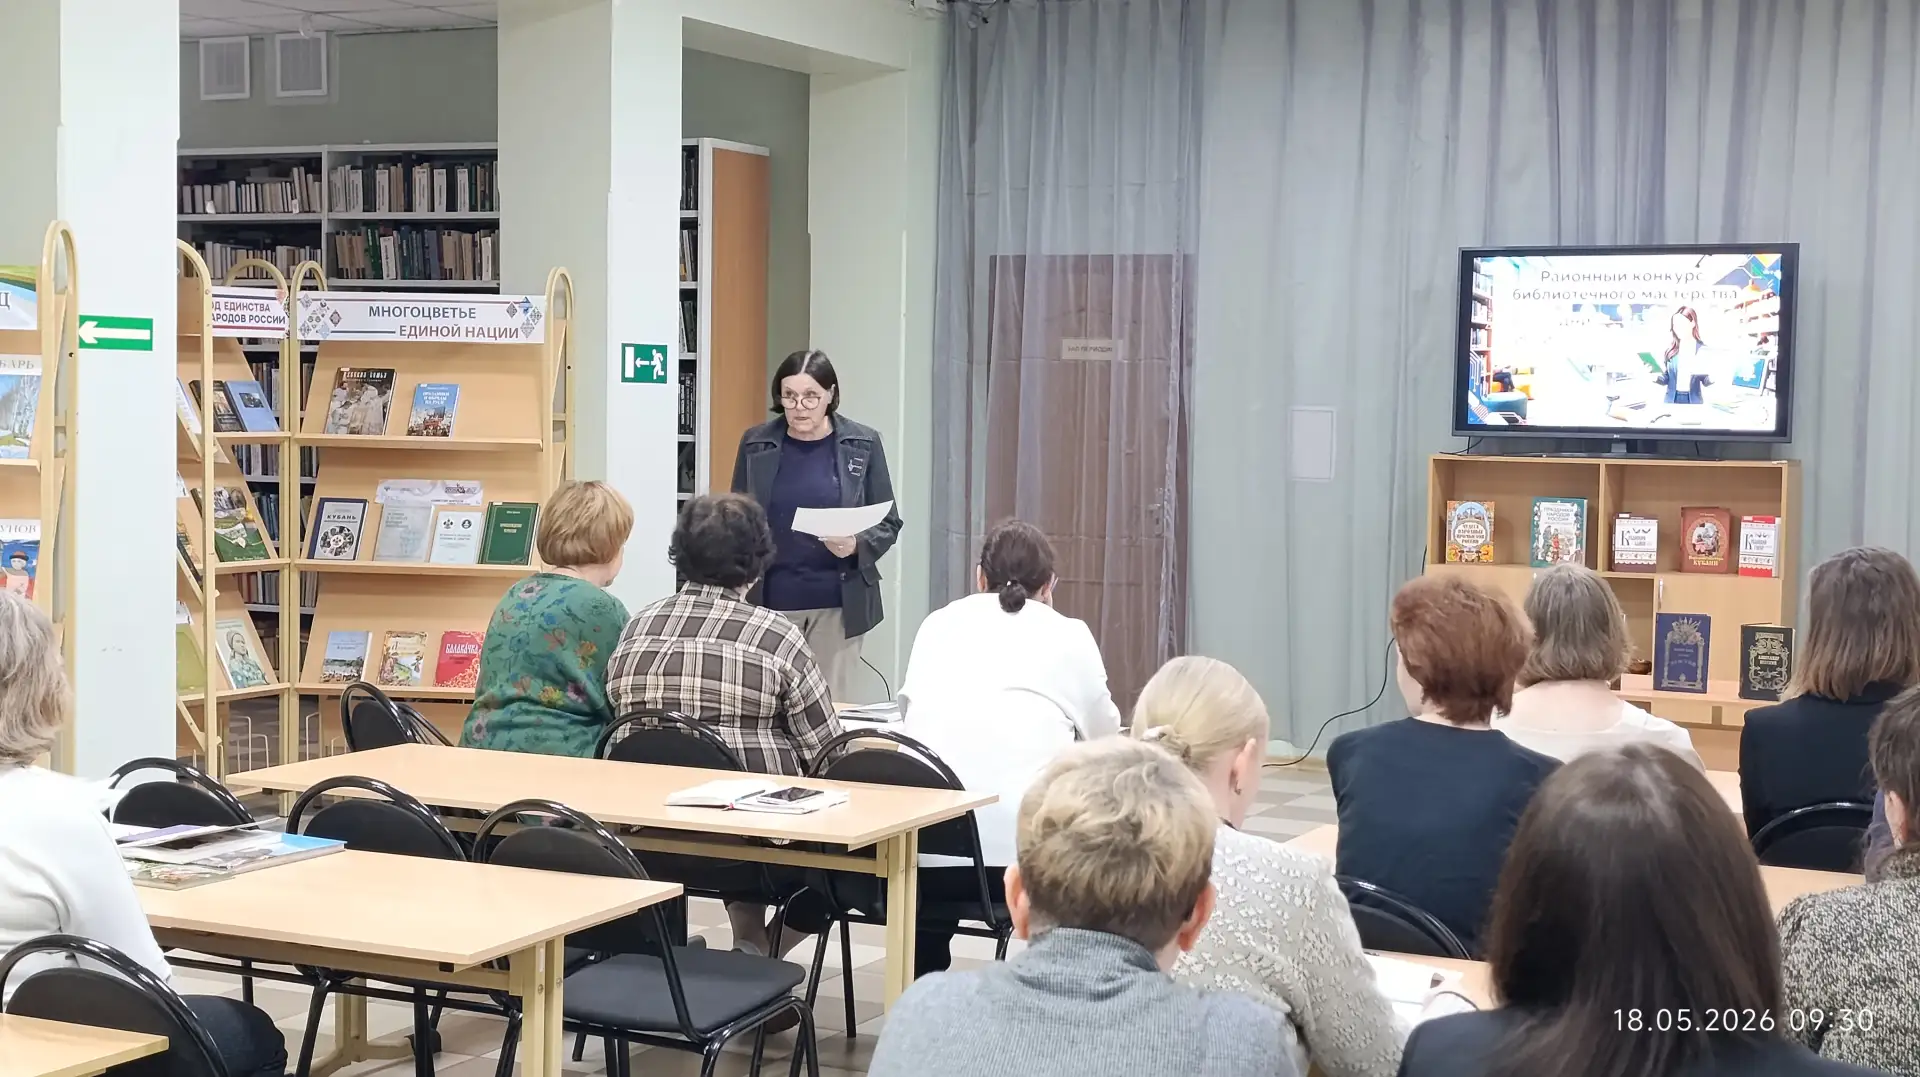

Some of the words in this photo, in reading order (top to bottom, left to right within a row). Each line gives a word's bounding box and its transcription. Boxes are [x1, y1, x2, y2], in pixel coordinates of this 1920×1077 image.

[1633, 272, 1704, 285] конкурс
[1513, 288, 1636, 300] библиотечного
[1642, 290, 1738, 301] мастерства
[224, 301, 271, 312] ЕДИНСТВА
[368, 305, 477, 320] МНОГОЦВЕТЬЕ
[249, 314, 286, 325] РОССИИ
[399, 324, 461, 339] ЕДИНОЙ
[465, 325, 519, 341] НАЦИИ
